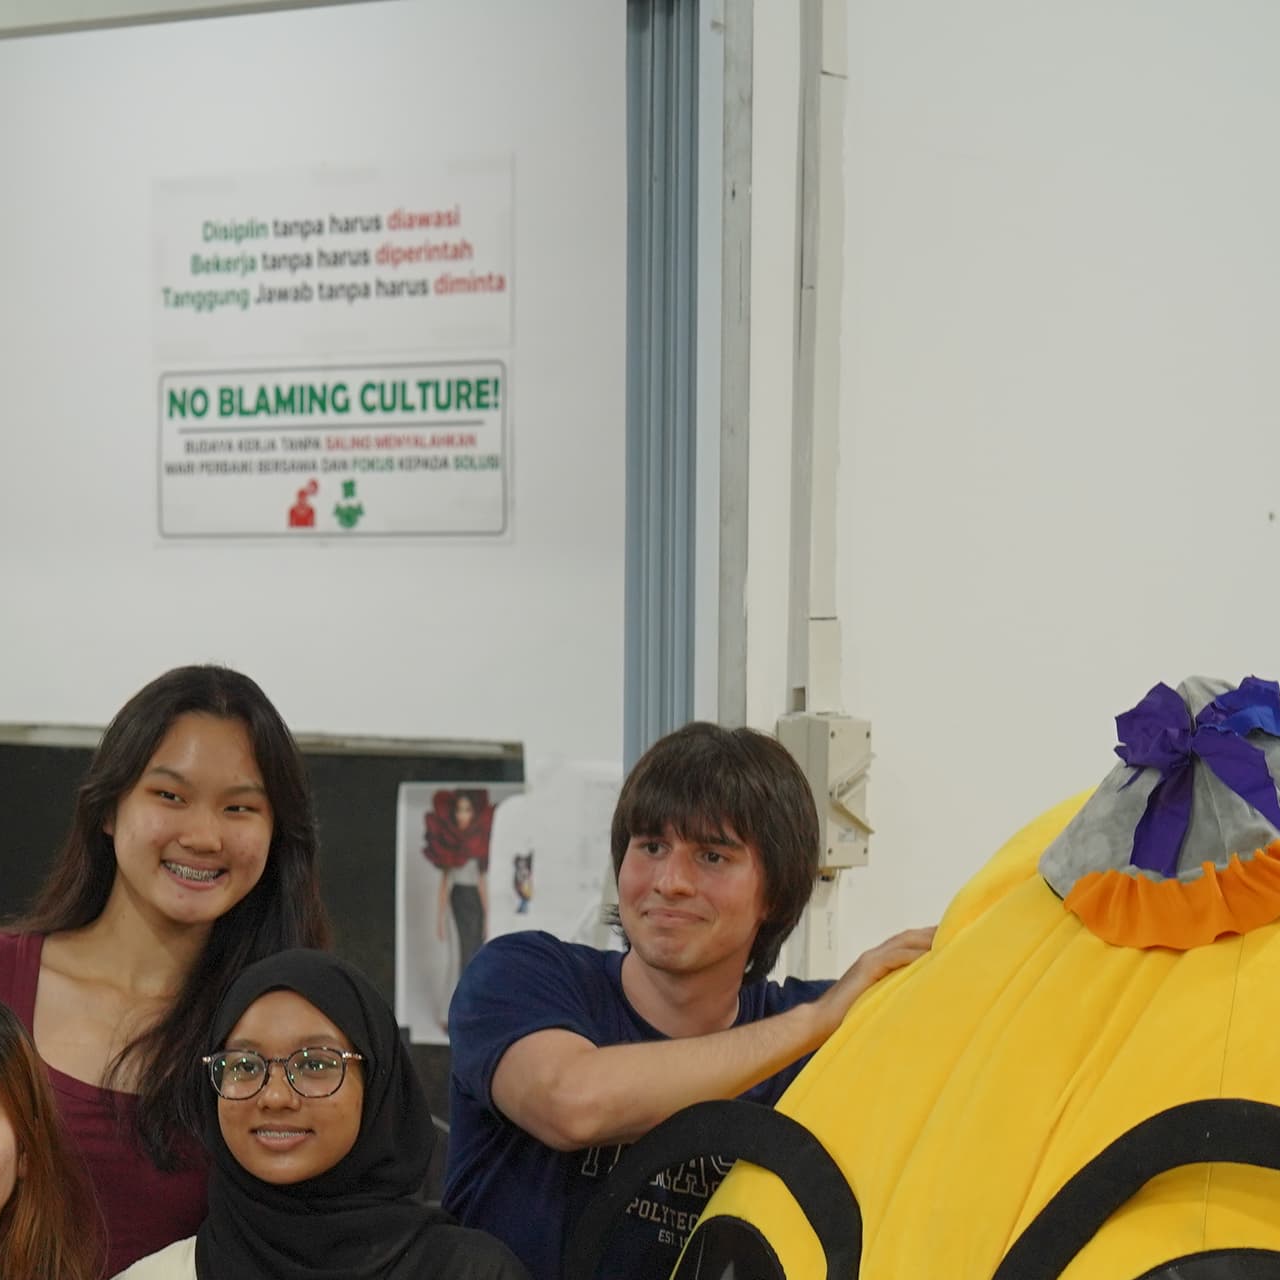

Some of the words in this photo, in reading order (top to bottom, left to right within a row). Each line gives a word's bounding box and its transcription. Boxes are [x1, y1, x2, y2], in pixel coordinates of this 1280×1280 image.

[202, 218, 269, 244] Disiplin
[273, 219, 324, 242] tanpa
[328, 213, 382, 234] harus
[387, 203, 461, 231] diawasi
[191, 252, 258, 278] Bekerja
[261, 252, 313, 276] tanpa
[317, 247, 370, 267] harus
[375, 238, 475, 270] diperintah
[163, 286, 251, 312] Tanggung
[255, 281, 313, 304] Jawab
[317, 282, 371, 306] tanpa
[375, 276, 429, 298] harus
[433, 269, 506, 296] diminta
[168, 387, 209, 419] NO
[219, 382, 350, 418] BLAMING
[360, 376, 500, 413] CULTURE!
